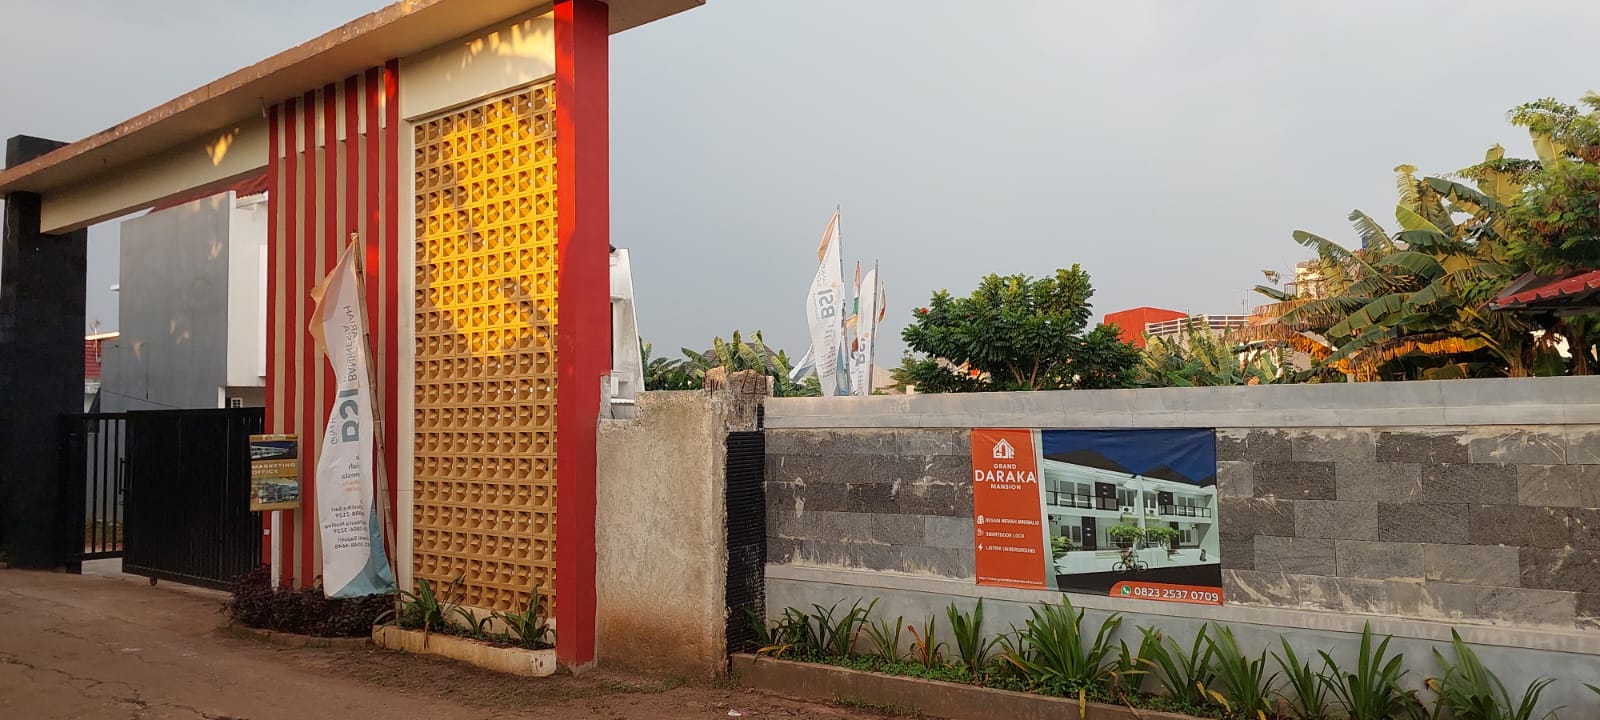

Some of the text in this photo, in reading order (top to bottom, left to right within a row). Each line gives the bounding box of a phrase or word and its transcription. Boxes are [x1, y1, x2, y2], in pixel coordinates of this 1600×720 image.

[974, 469, 1037, 483] DARAKA
[1003, 546, 1036, 554] UNDERGROUND
[1134, 587, 1219, 602] 0823 2537 0709
